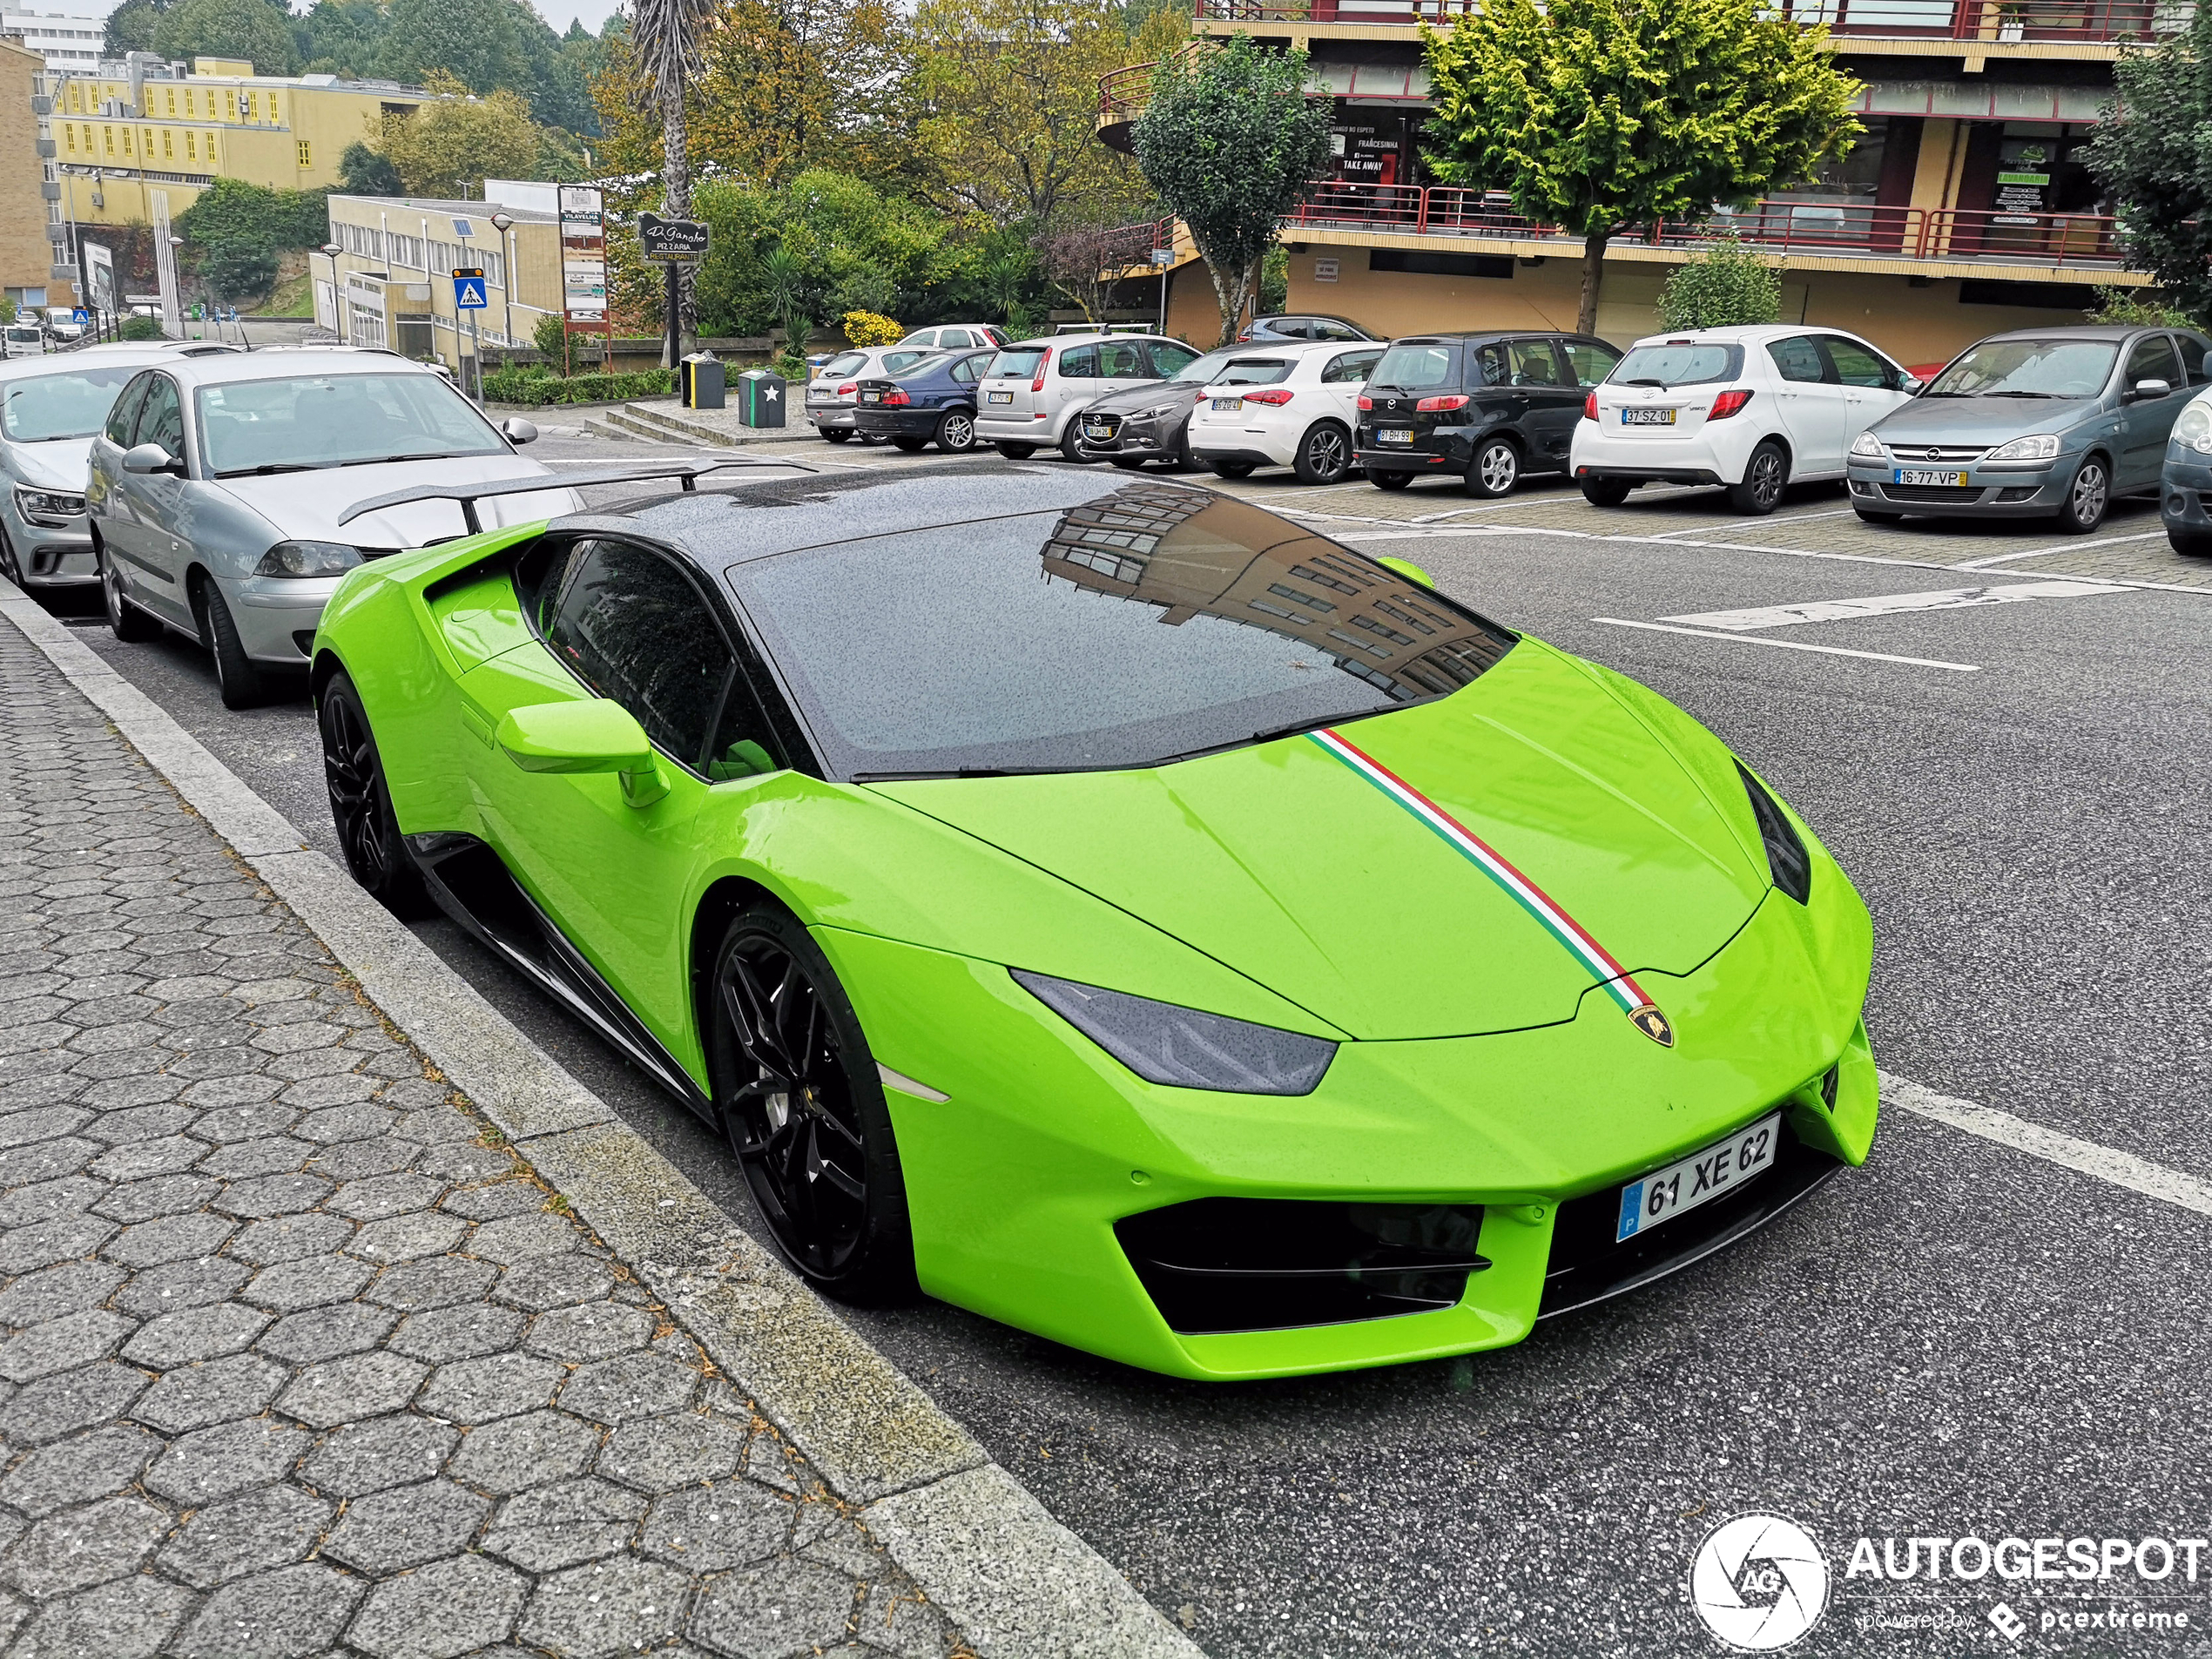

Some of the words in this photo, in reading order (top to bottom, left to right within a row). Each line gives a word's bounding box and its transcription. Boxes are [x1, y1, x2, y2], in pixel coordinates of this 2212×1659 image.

[1344, 159, 1362, 170] TAKE
[1363, 160, 1384, 171] AWAY
[657, 242, 691, 251] PIZZARIA
[650, 252, 698, 261] RESTAURANTE
[1648, 1172, 1681, 1217] 61
[1689, 1148, 1732, 1198] XE
[1738, 1129, 1770, 1171] 62
